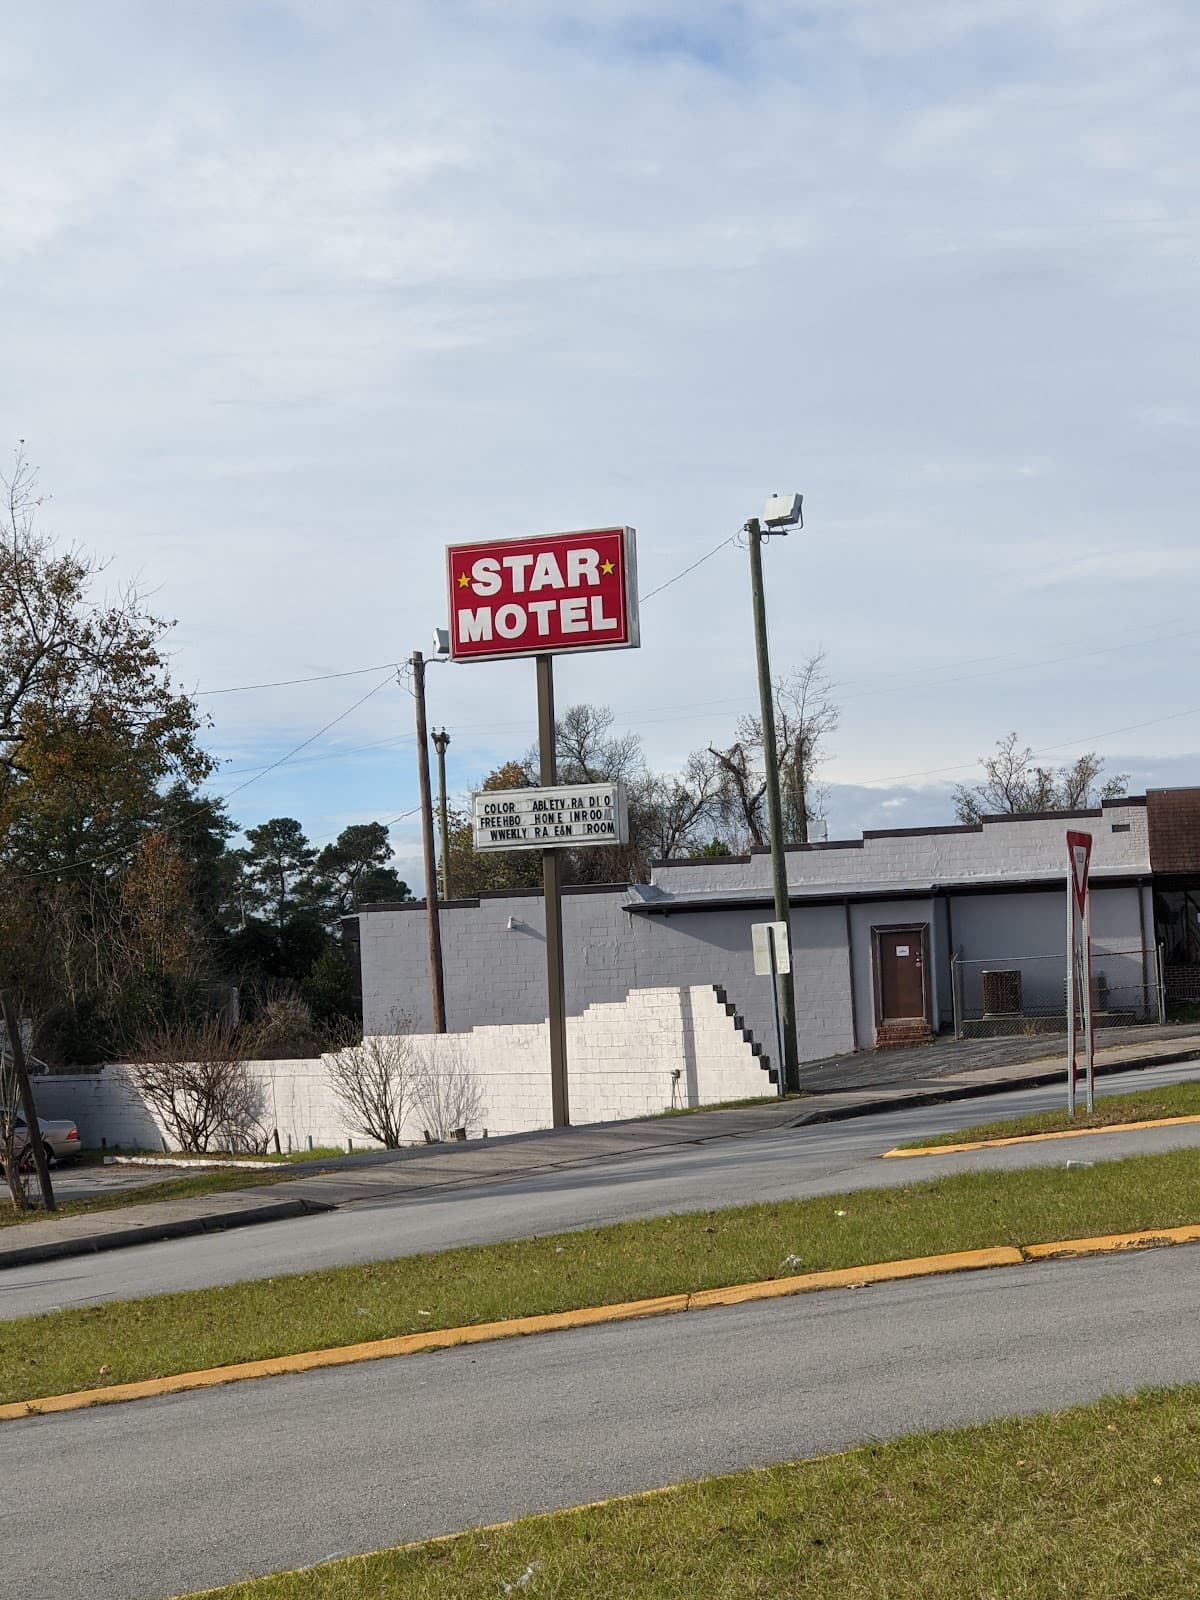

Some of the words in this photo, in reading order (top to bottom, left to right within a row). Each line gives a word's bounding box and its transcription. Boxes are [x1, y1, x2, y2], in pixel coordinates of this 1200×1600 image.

[471, 548, 600, 597] STAR
[458, 595, 618, 643] MOTEL
[484, 802, 515, 814] COLOR
[587, 822, 615, 834] ROOM
